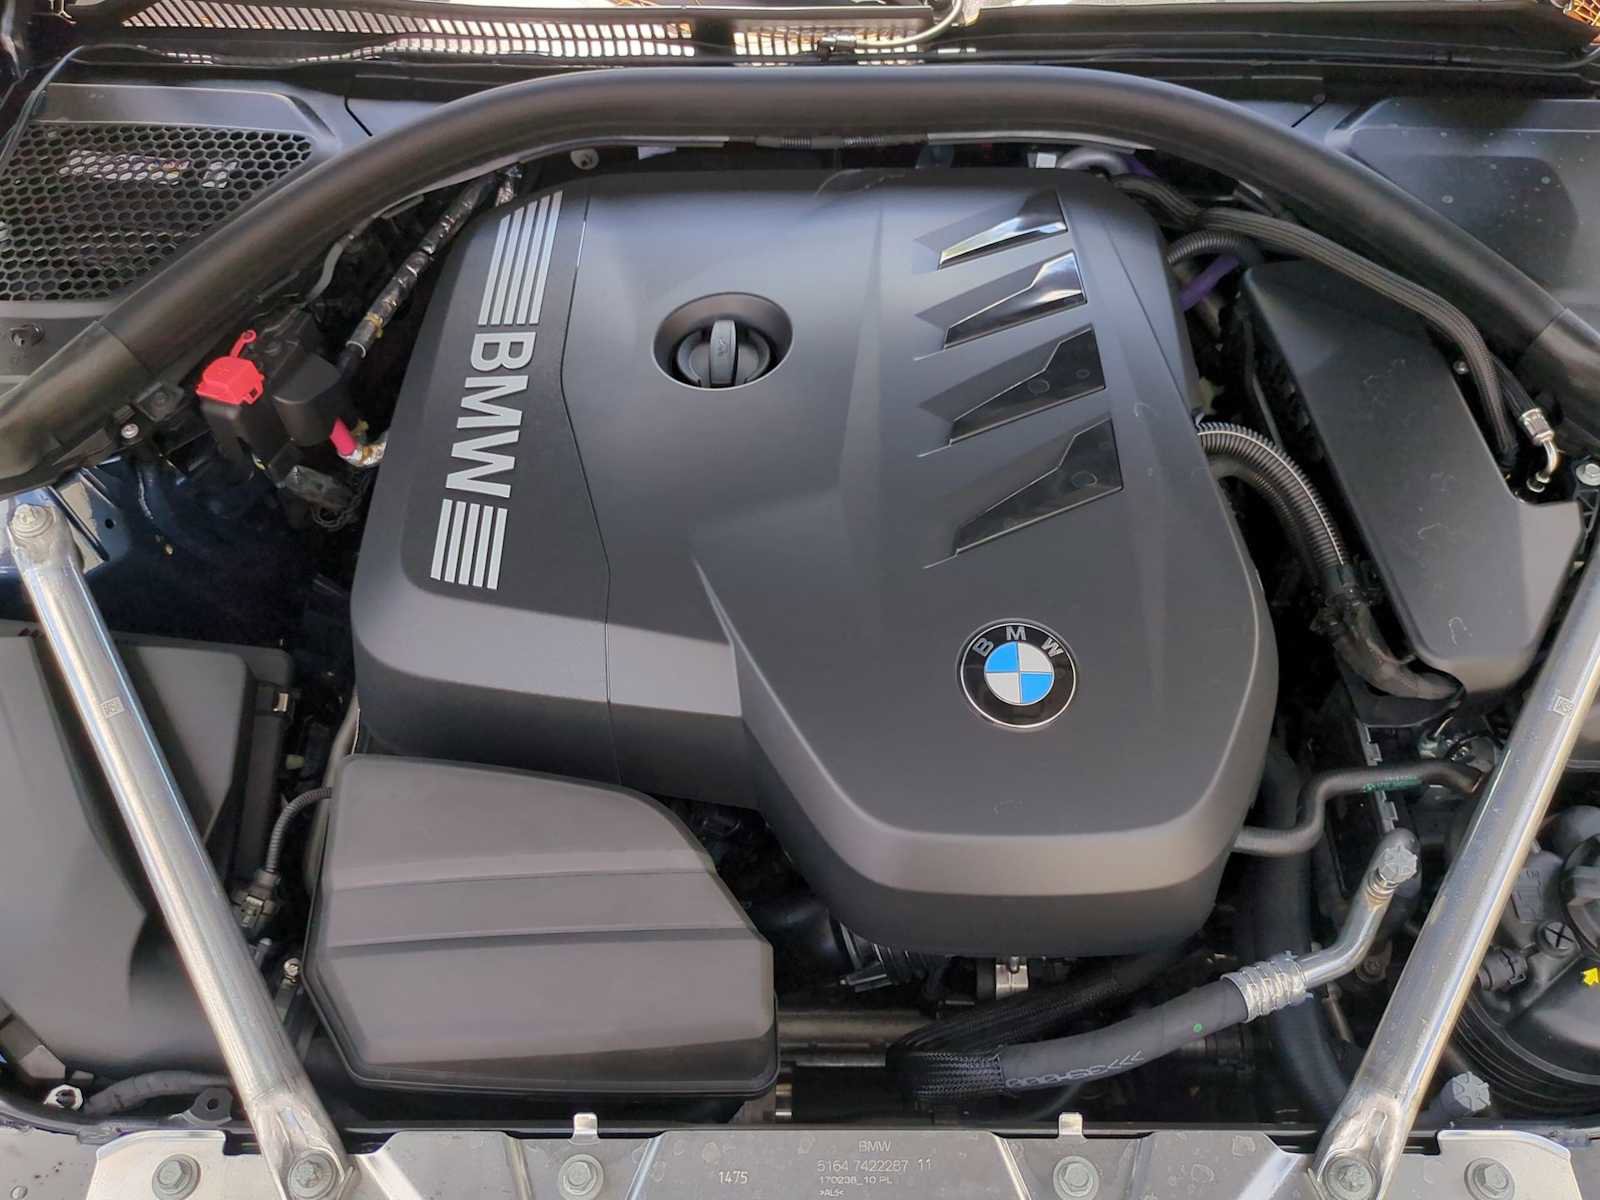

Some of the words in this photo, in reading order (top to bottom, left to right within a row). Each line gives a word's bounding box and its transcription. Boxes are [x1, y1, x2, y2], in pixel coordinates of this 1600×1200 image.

[445, 331, 536, 498] BMW
[972, 625, 1064, 657] BMW
[859, 1140, 892, 1153] BMW
[917, 1158, 933, 1171] 11
[718, 1171, 749, 1185] 1475
